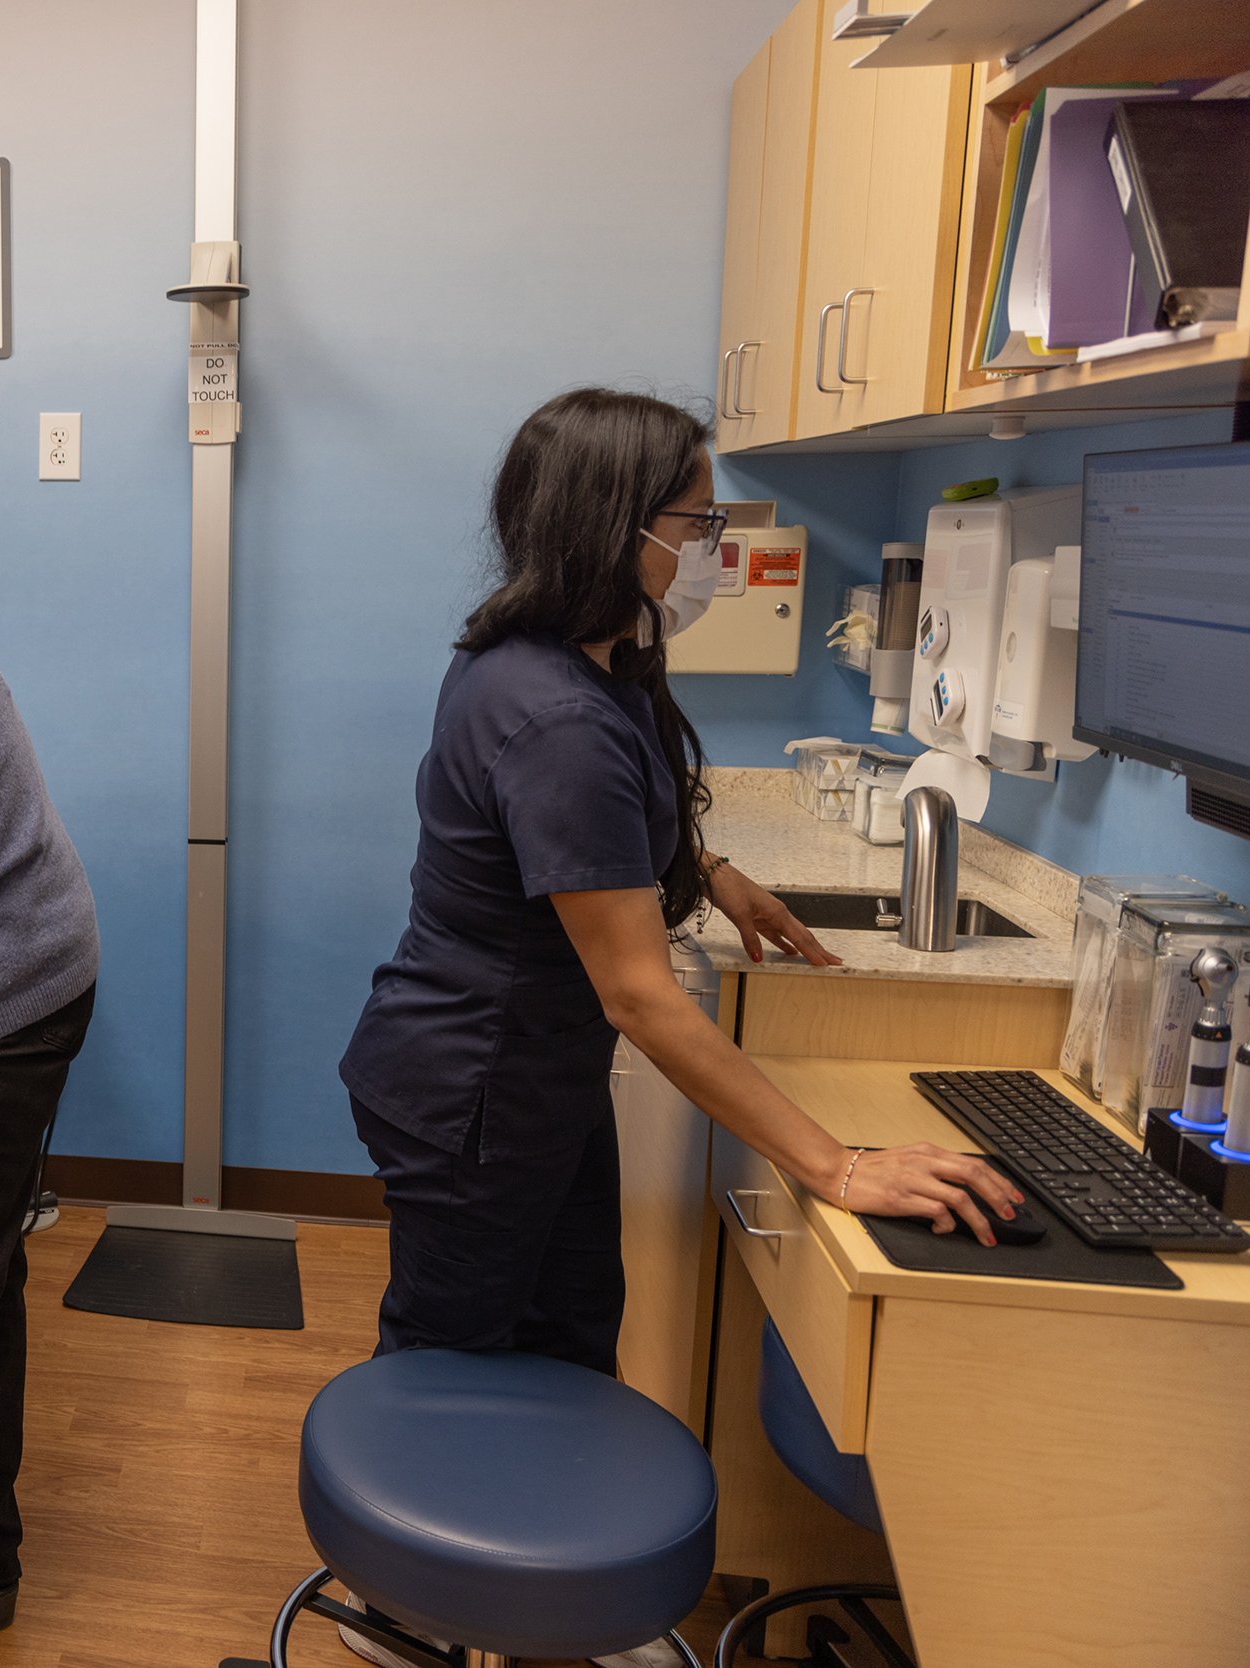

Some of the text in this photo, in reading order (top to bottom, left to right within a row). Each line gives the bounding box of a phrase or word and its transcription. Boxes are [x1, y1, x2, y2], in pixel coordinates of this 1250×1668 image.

[206, 357, 225, 369] DO
[202, 374, 228, 385] NOT
[192, 390, 235, 402] TOUCH
